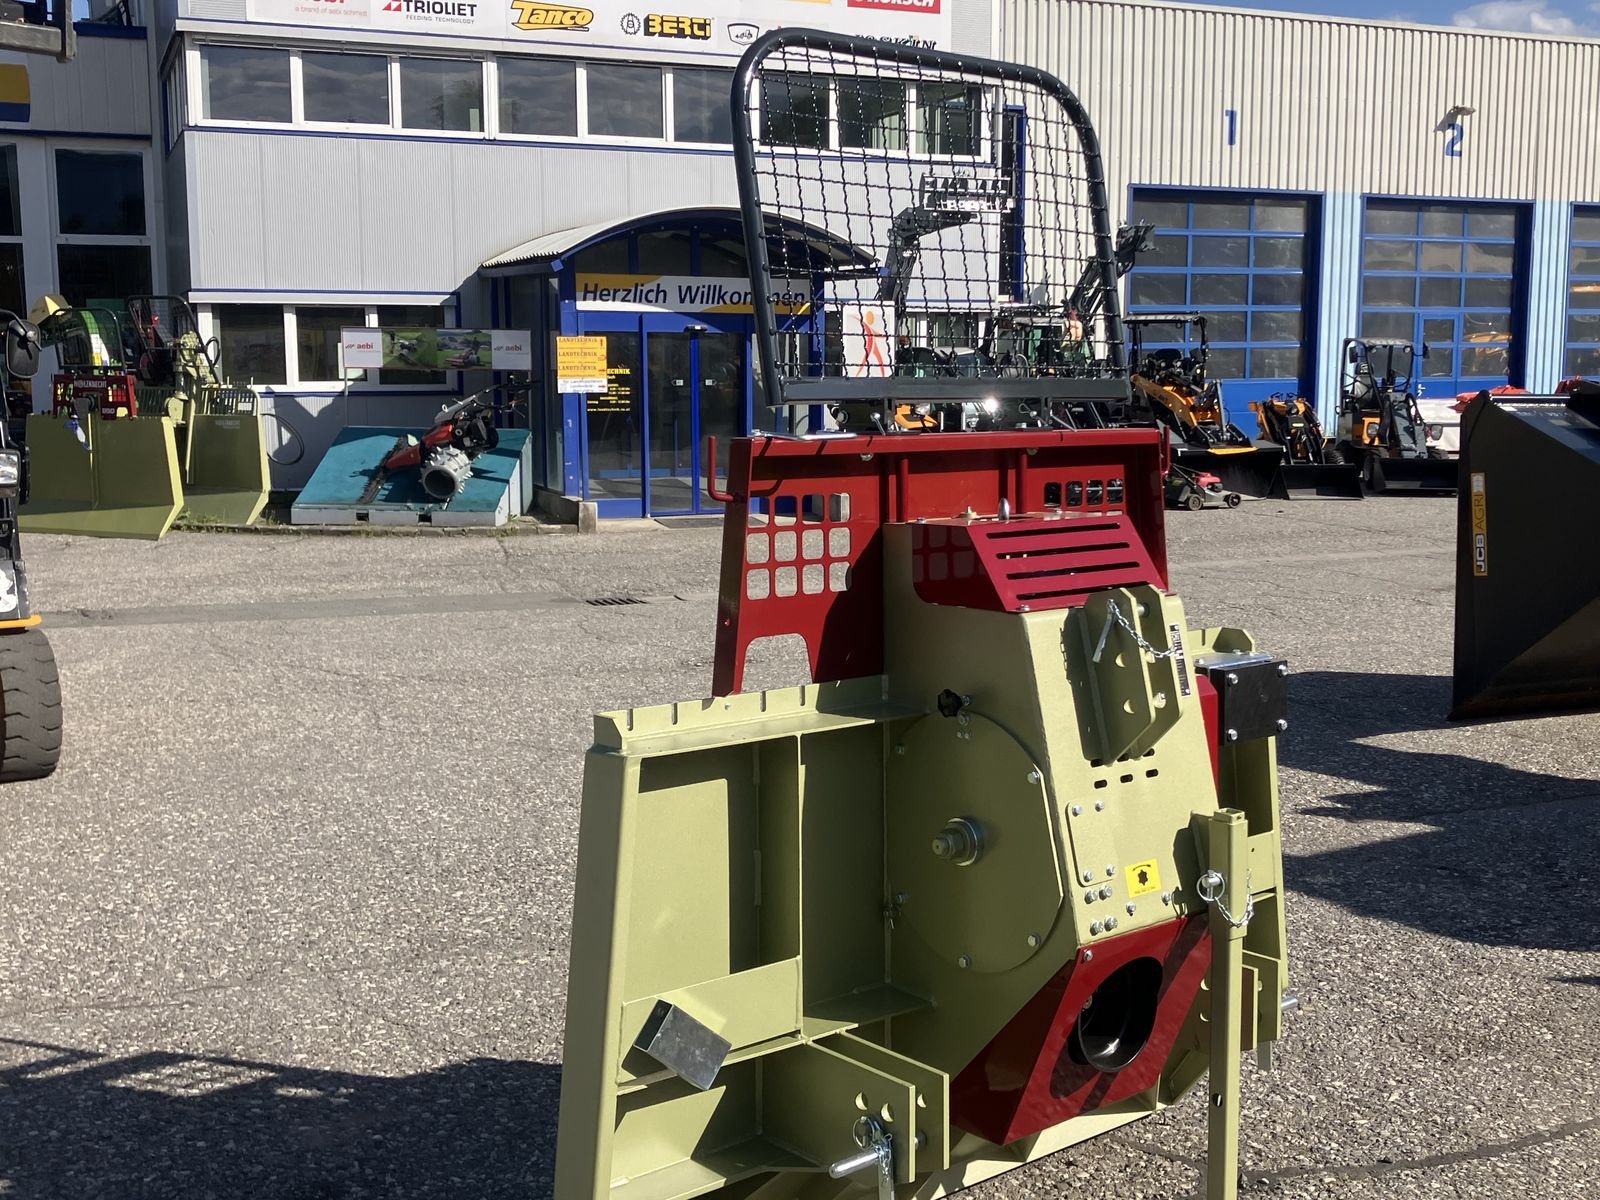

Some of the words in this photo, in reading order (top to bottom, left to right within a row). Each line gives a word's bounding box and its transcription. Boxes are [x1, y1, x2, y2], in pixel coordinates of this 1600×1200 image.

[406, 0, 477, 16] TRIOLIET
[406, 14, 433, 22] FEEDING
[435, 16, 475, 25] TECHNOLOGY
[511, 0, 594, 30] Tanco
[1225, 109, 1237, 146] 1
[1445, 123, 1464, 157] 2
[582, 282, 667, 304] Herzlich
[356, 342, 374, 350] aebi
[505, 344, 522, 352] aebi
[1474, 494, 1485, 531] AGRI
[1475, 534, 1486, 573] JCB
